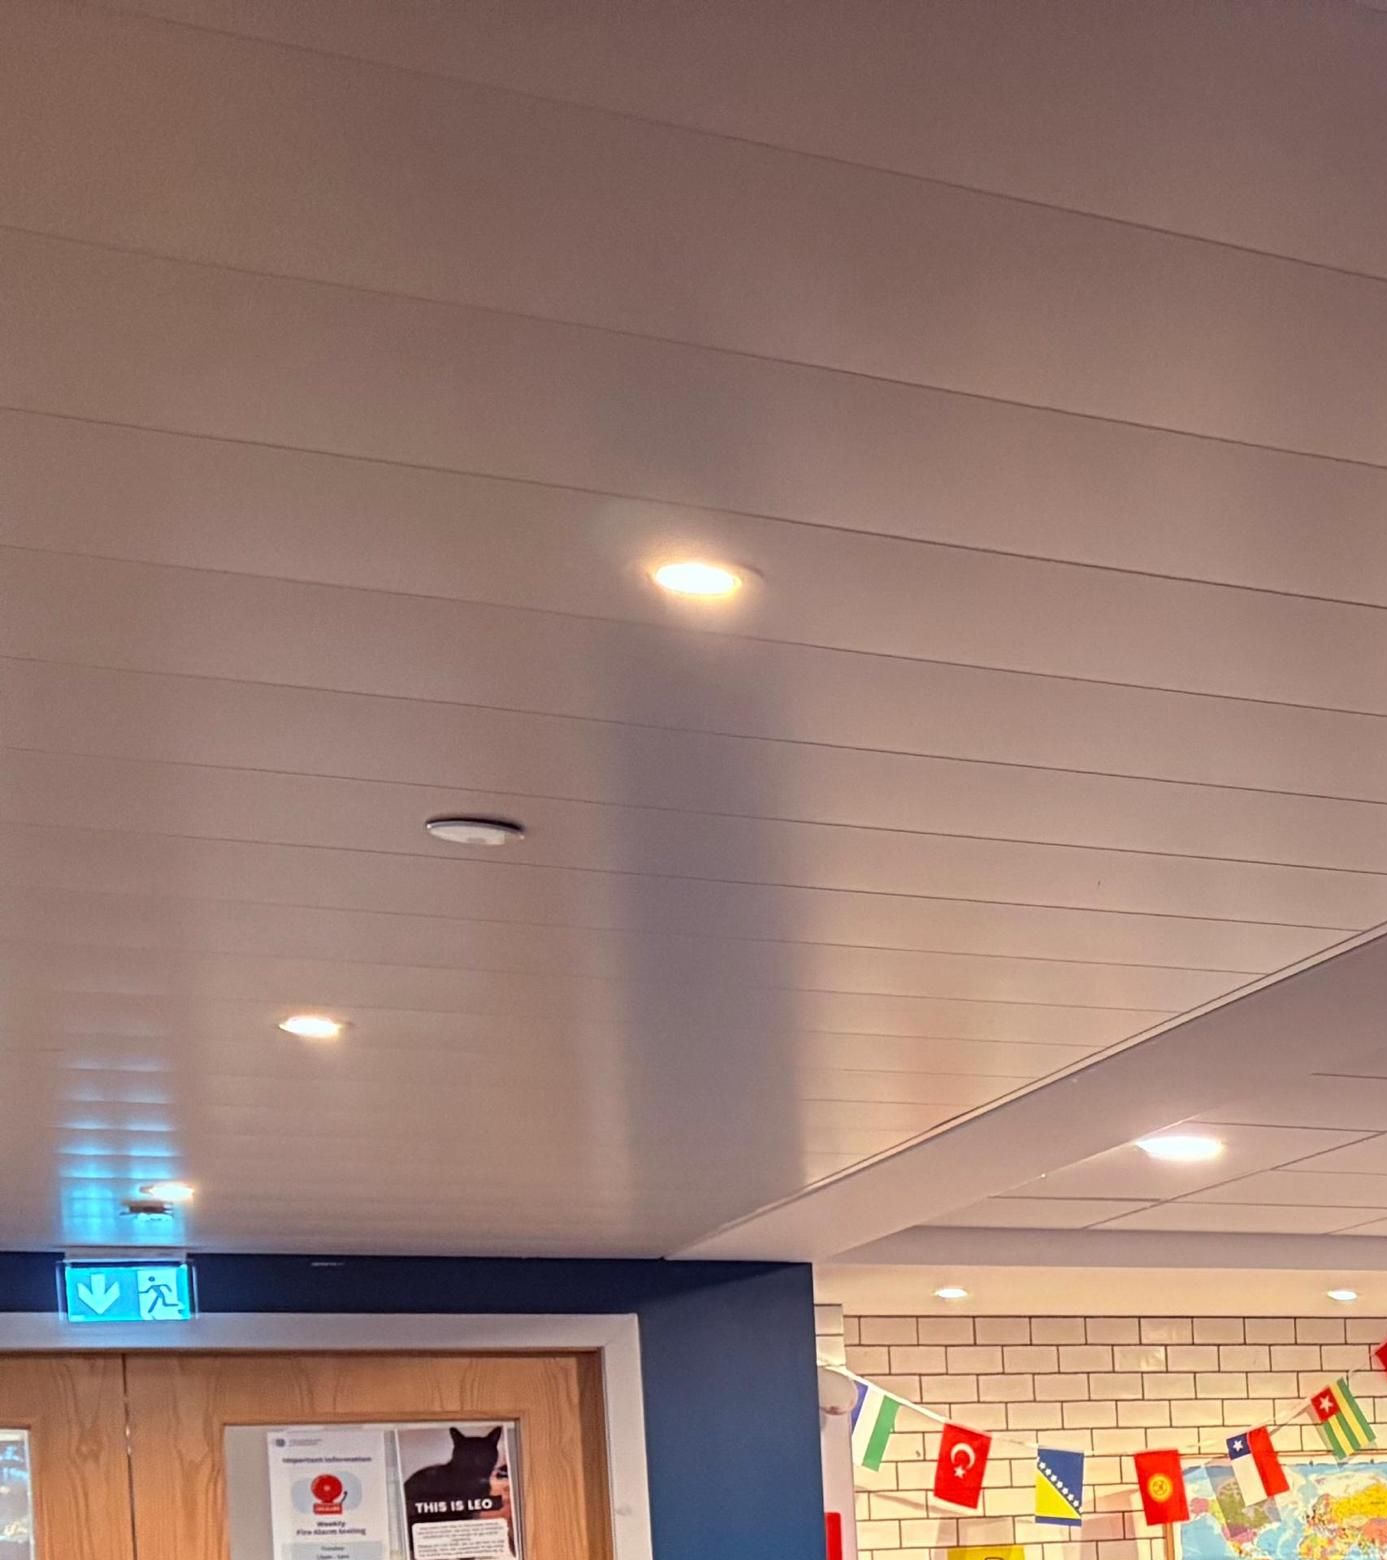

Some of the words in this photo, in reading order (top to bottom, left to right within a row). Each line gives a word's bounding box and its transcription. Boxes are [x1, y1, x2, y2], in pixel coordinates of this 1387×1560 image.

[415, 1501, 448, 1513] THIS
[450, 1500, 464, 1512] IS
[467, 1498, 493, 1511] LEO
